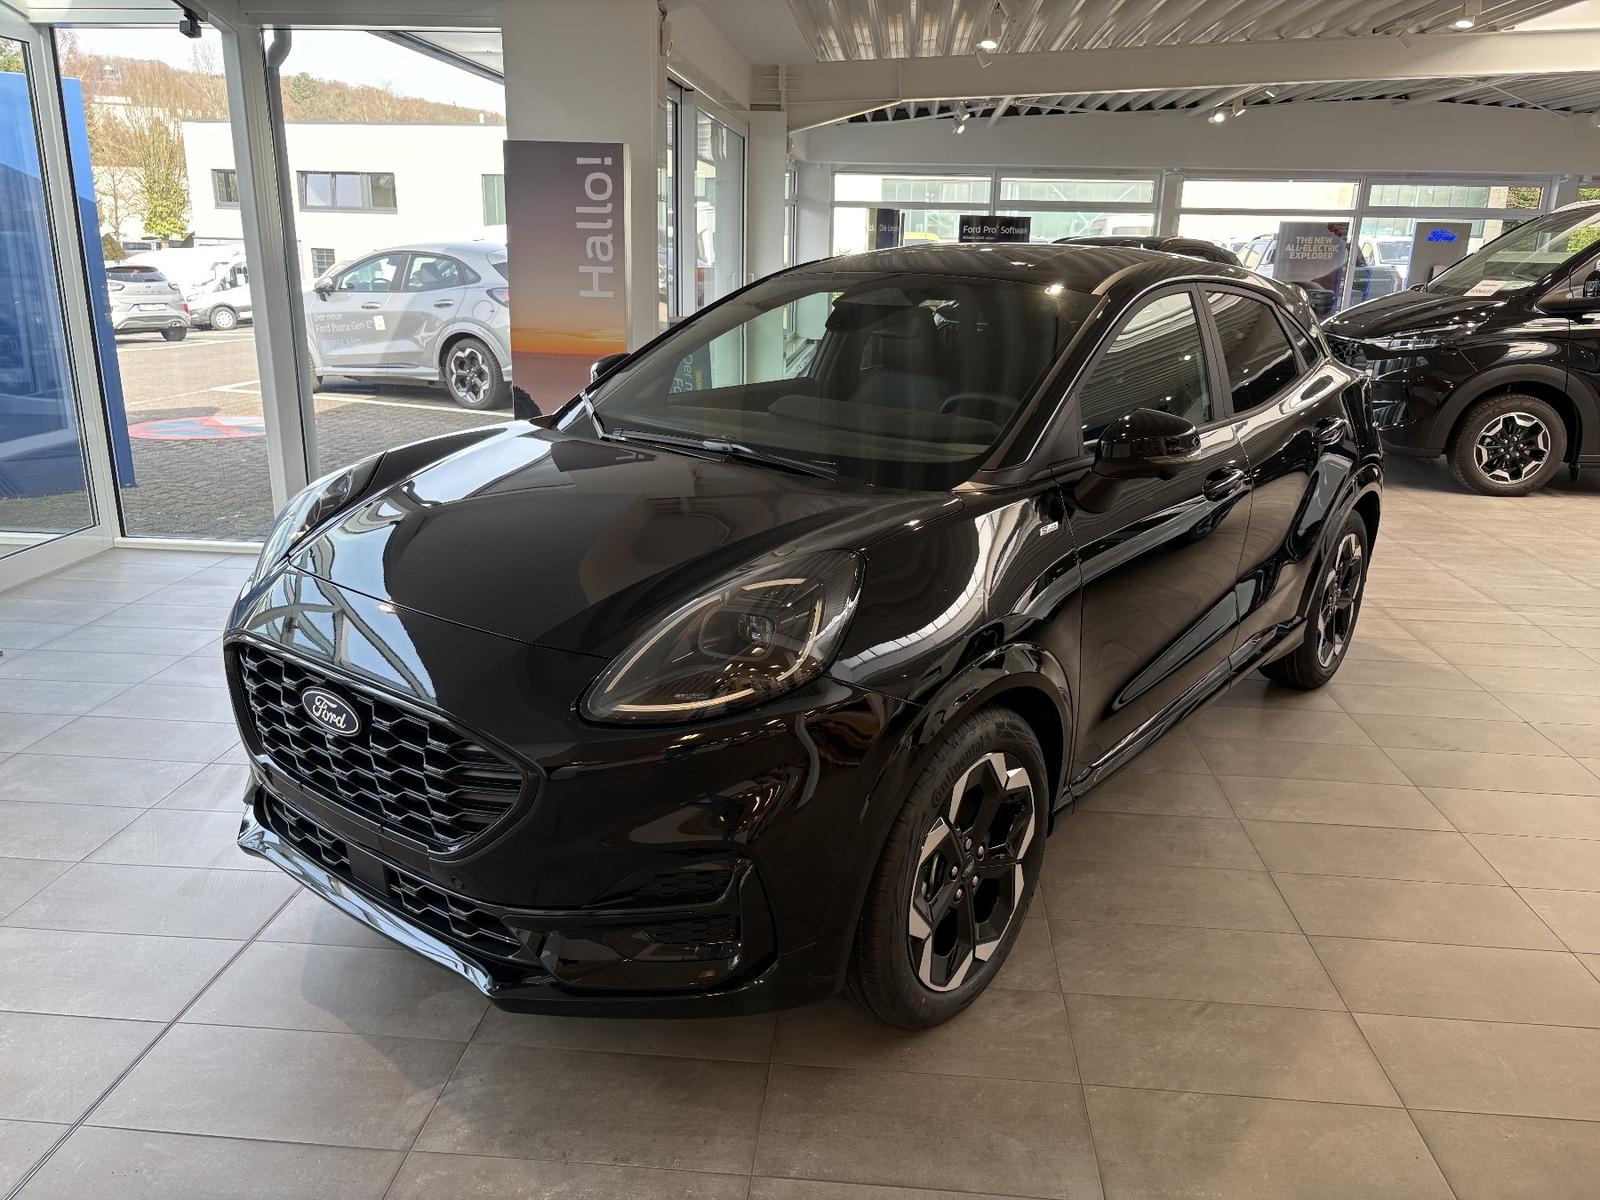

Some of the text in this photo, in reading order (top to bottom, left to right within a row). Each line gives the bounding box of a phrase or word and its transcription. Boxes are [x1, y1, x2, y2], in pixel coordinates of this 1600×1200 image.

[576, 157, 614, 298] Hallo!
[963, 225, 981, 234] Ford
[1000, 225, 1028, 235] Software
[1296, 236, 1333, 245] THE NEW
[1285, 244, 1339, 252] ALL-ELECTRIC
[1289, 252, 1333, 260] EXPLORER
[315, 323, 331, 333] Ford
[331, 323, 350, 332] Puma
[312, 695, 347, 729] Ford
